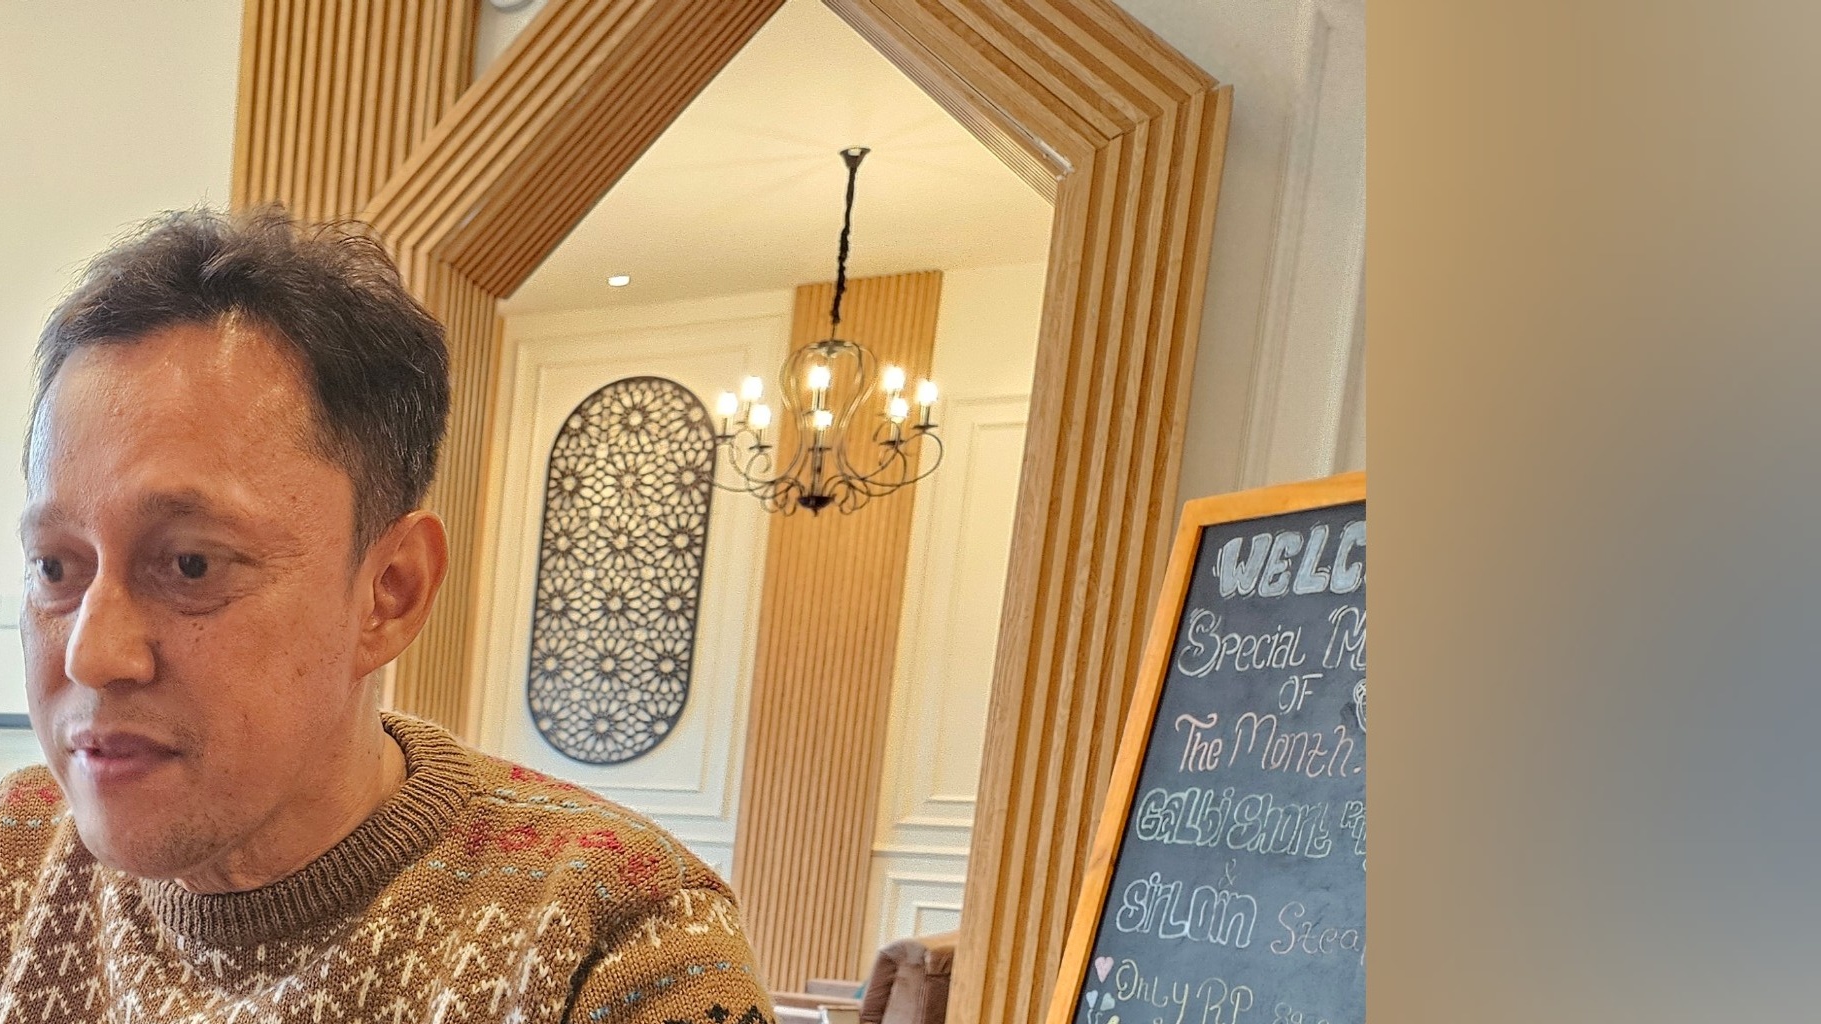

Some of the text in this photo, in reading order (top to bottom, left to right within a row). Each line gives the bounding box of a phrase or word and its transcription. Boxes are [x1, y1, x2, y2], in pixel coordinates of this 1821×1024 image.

[1178, 608, 1306, 678] Special
[1175, 712, 1223, 773] The
[1270, 901, 1366, 966] Stea
